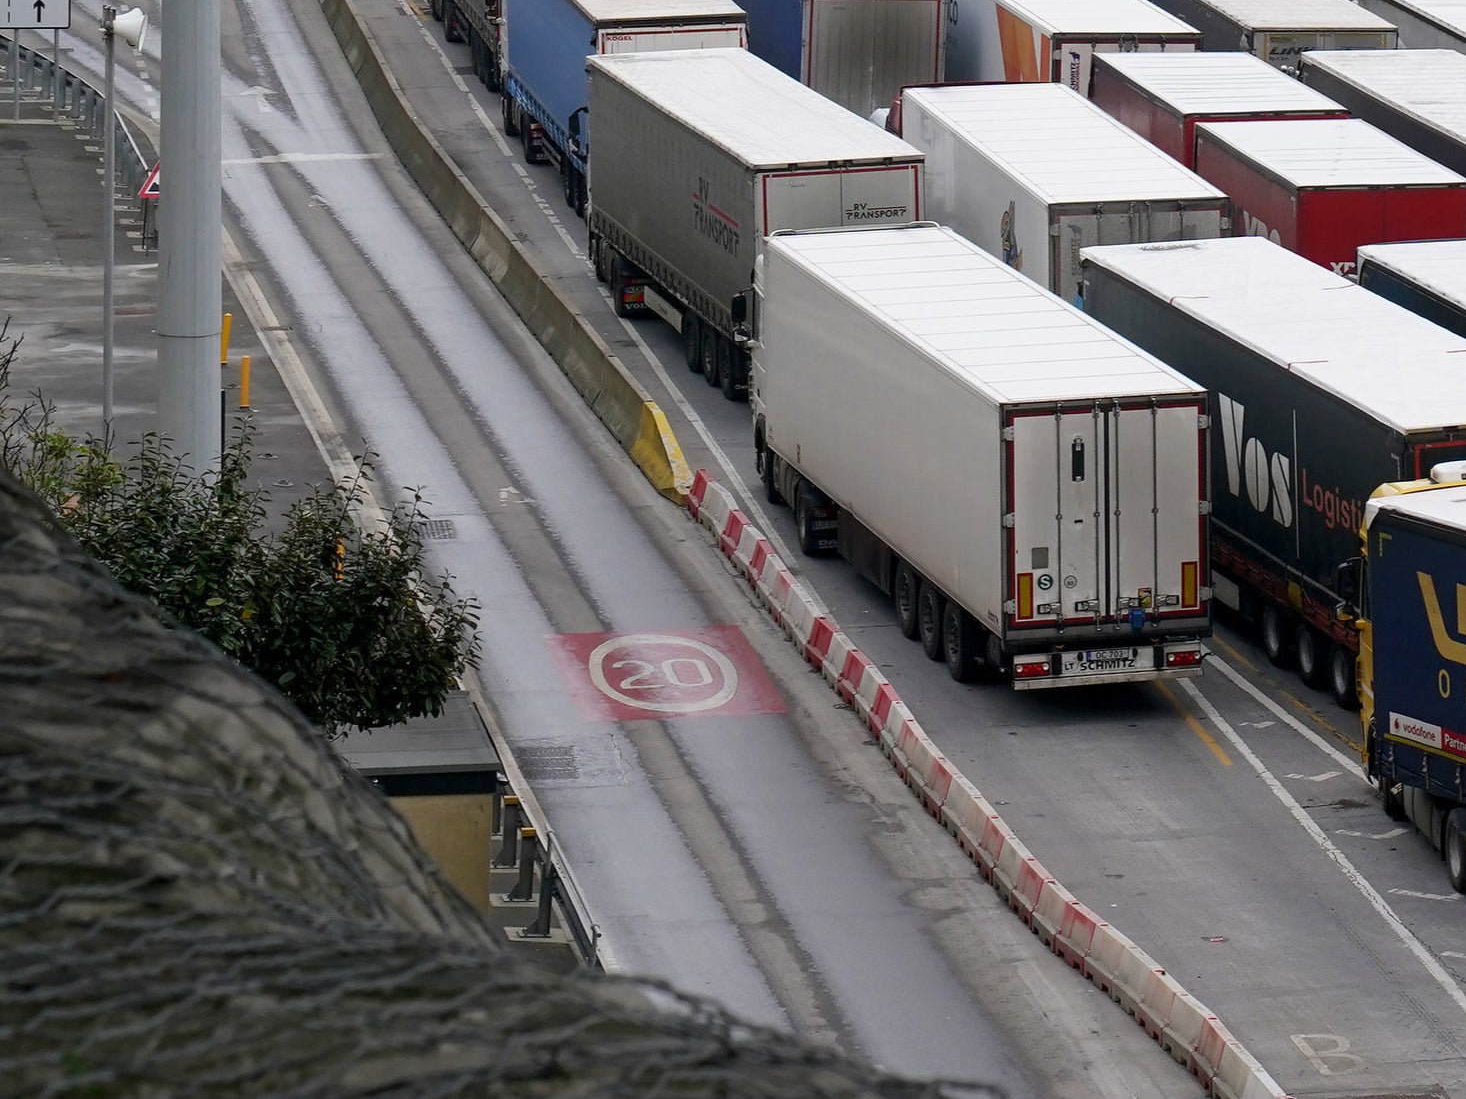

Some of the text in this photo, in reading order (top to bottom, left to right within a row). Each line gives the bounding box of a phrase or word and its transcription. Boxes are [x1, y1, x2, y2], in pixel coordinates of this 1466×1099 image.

[845, 208, 907, 220] TRANSPORT
[1302, 468, 1362, 534] Logisti
[611, 660, 714, 689] 20
[1065, 662, 1074, 671] LT
[1080, 659, 1135, 672] SCHMITZ
[1403, 723, 1436, 742] vodafone
[1290, 1033, 1367, 1076] B
